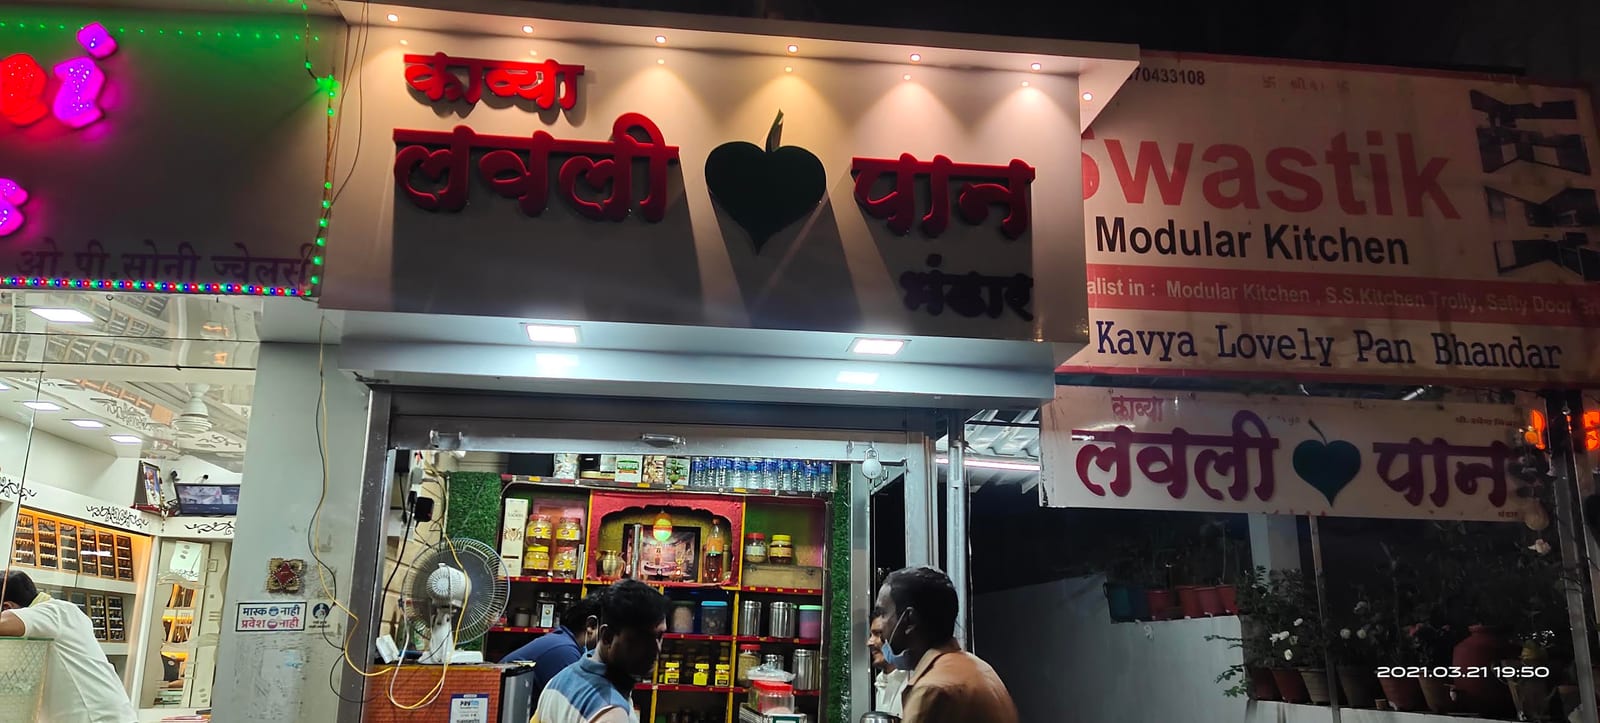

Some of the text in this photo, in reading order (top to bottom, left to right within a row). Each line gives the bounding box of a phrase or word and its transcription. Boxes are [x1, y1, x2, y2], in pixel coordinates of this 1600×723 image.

[404, 51, 585, 110] काव्या
[393, 112, 1036, 241] लवली पान
[212, 242, 314, 287] ज्वेलर्स
[1096, 216, 1409, 265] Modular Kitchen
[899, 253, 1034, 321] भंडार
[1167, 280, 1238, 300] Modular
[1244, 283, 1309, 303] Kitchen
[1097, 320, 1563, 370] Kavya Lovely Pan Bhandar
[1112, 395, 1164, 422] काव्या
[1072, 409, 1512, 507] लवली पान
[241, 617, 266, 628] प्रवेश
[279, 616, 299, 628] नाही
[242, 604, 300, 617] मास्क नाही
